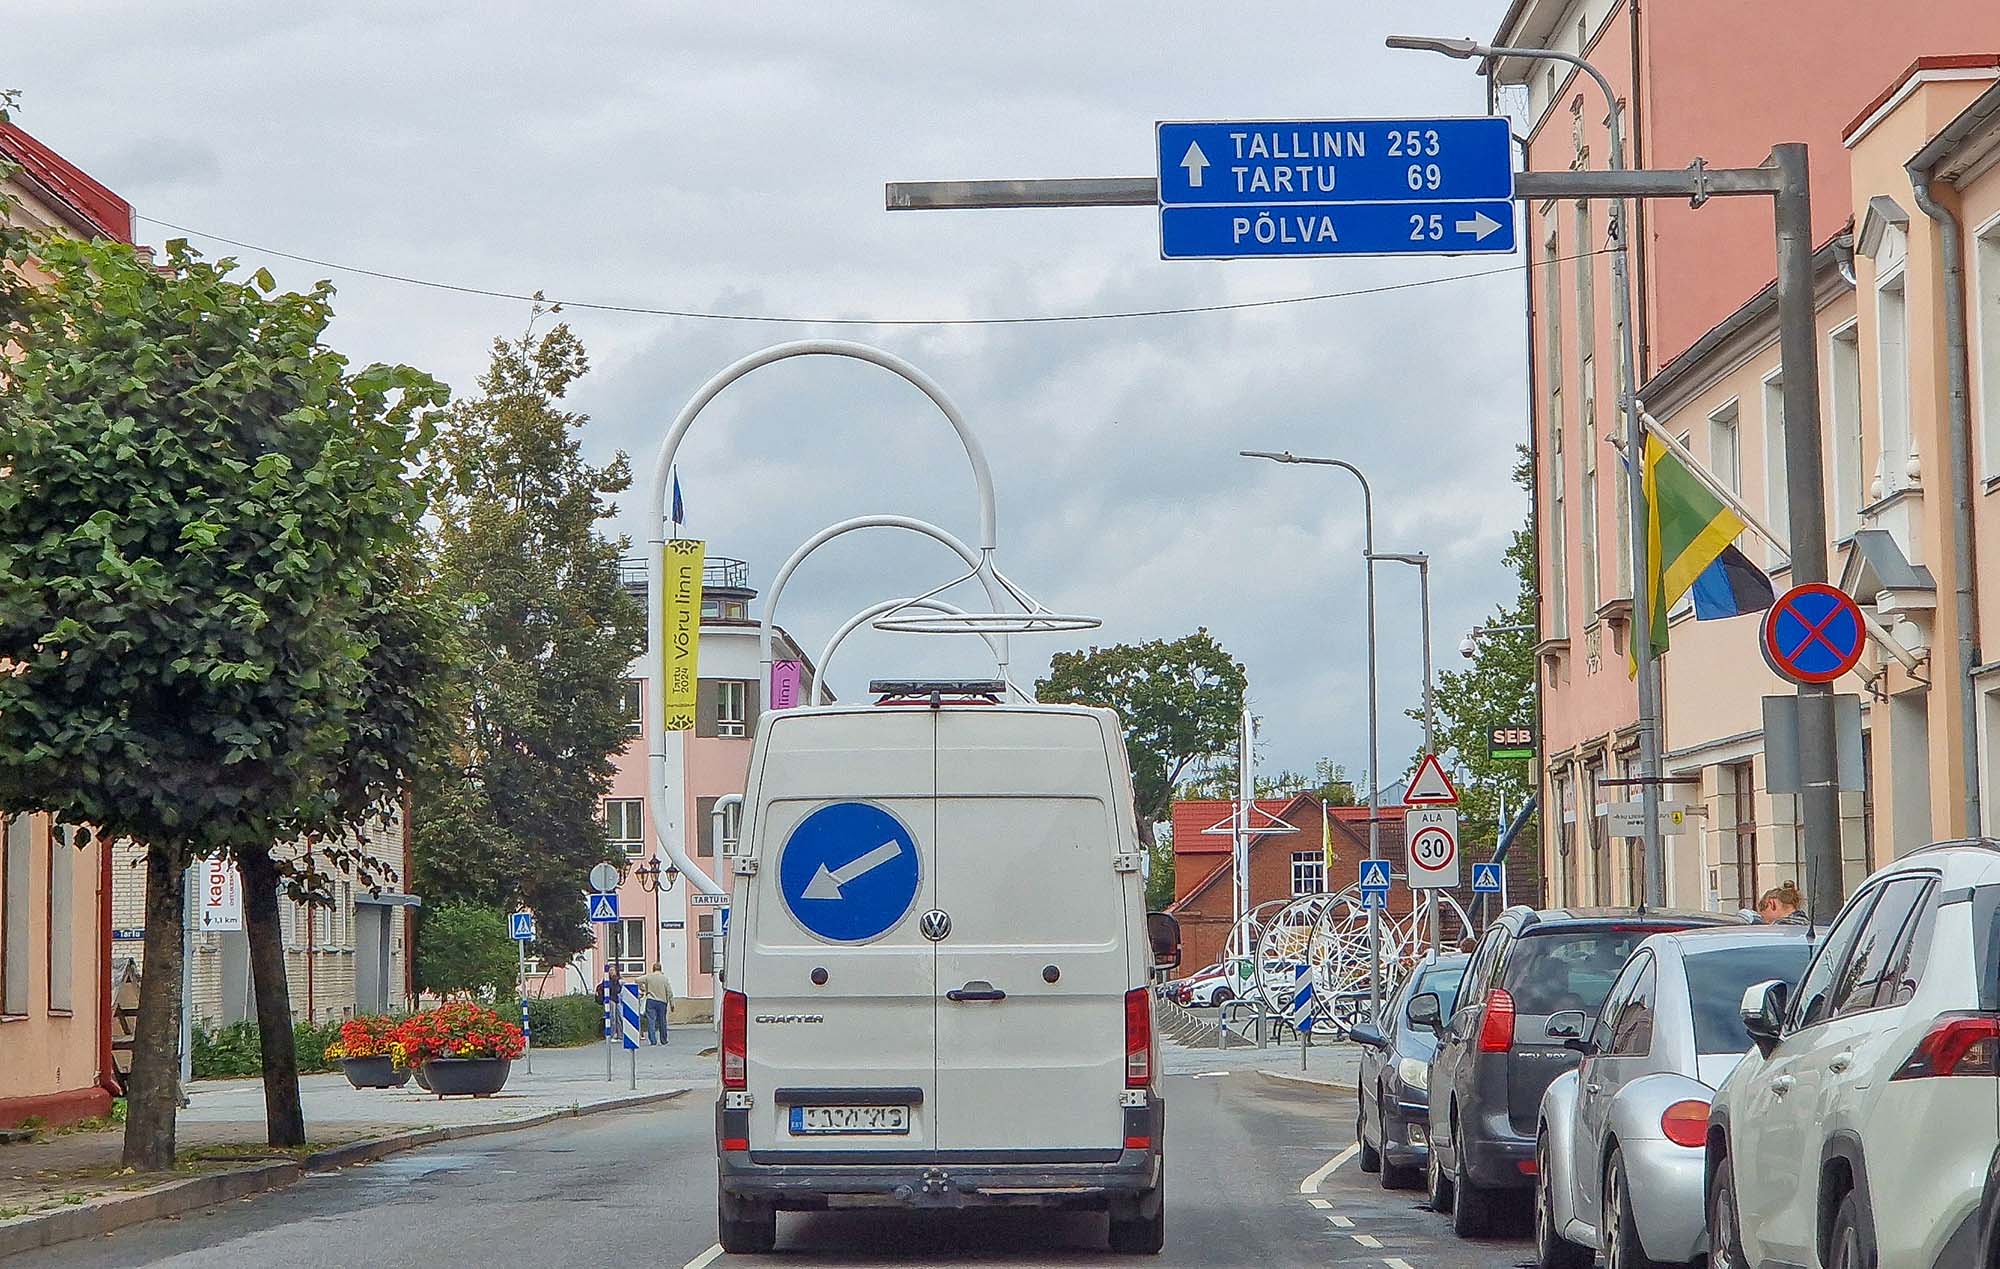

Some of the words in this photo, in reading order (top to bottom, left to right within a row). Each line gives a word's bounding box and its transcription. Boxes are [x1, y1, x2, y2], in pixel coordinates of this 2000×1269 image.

[1229, 130, 1367, 159] TALLINN
[1387, 129, 1441, 157] 253
[1231, 165, 1336, 193] TARTU
[1407, 164, 1442, 191] 69
[1232, 211, 1339, 244] PÕLVA
[1409, 214, 1444, 242] 25
[673, 565, 691, 604] linn
[673, 611, 690, 660] Võru
[672, 667, 681, 694] Tartu
[681, 667, 689, 693] 2024
[777, 678, 791, 706] linn
[1493, 729, 1532, 746] SEB
[1422, 813, 1443, 823] ALA
[1421, 838, 1444, 858] 30
[694, 896, 719, 904] TARTU
[224, 916, 238, 924] km
[755, 1014, 825, 1025] CRAFTER
